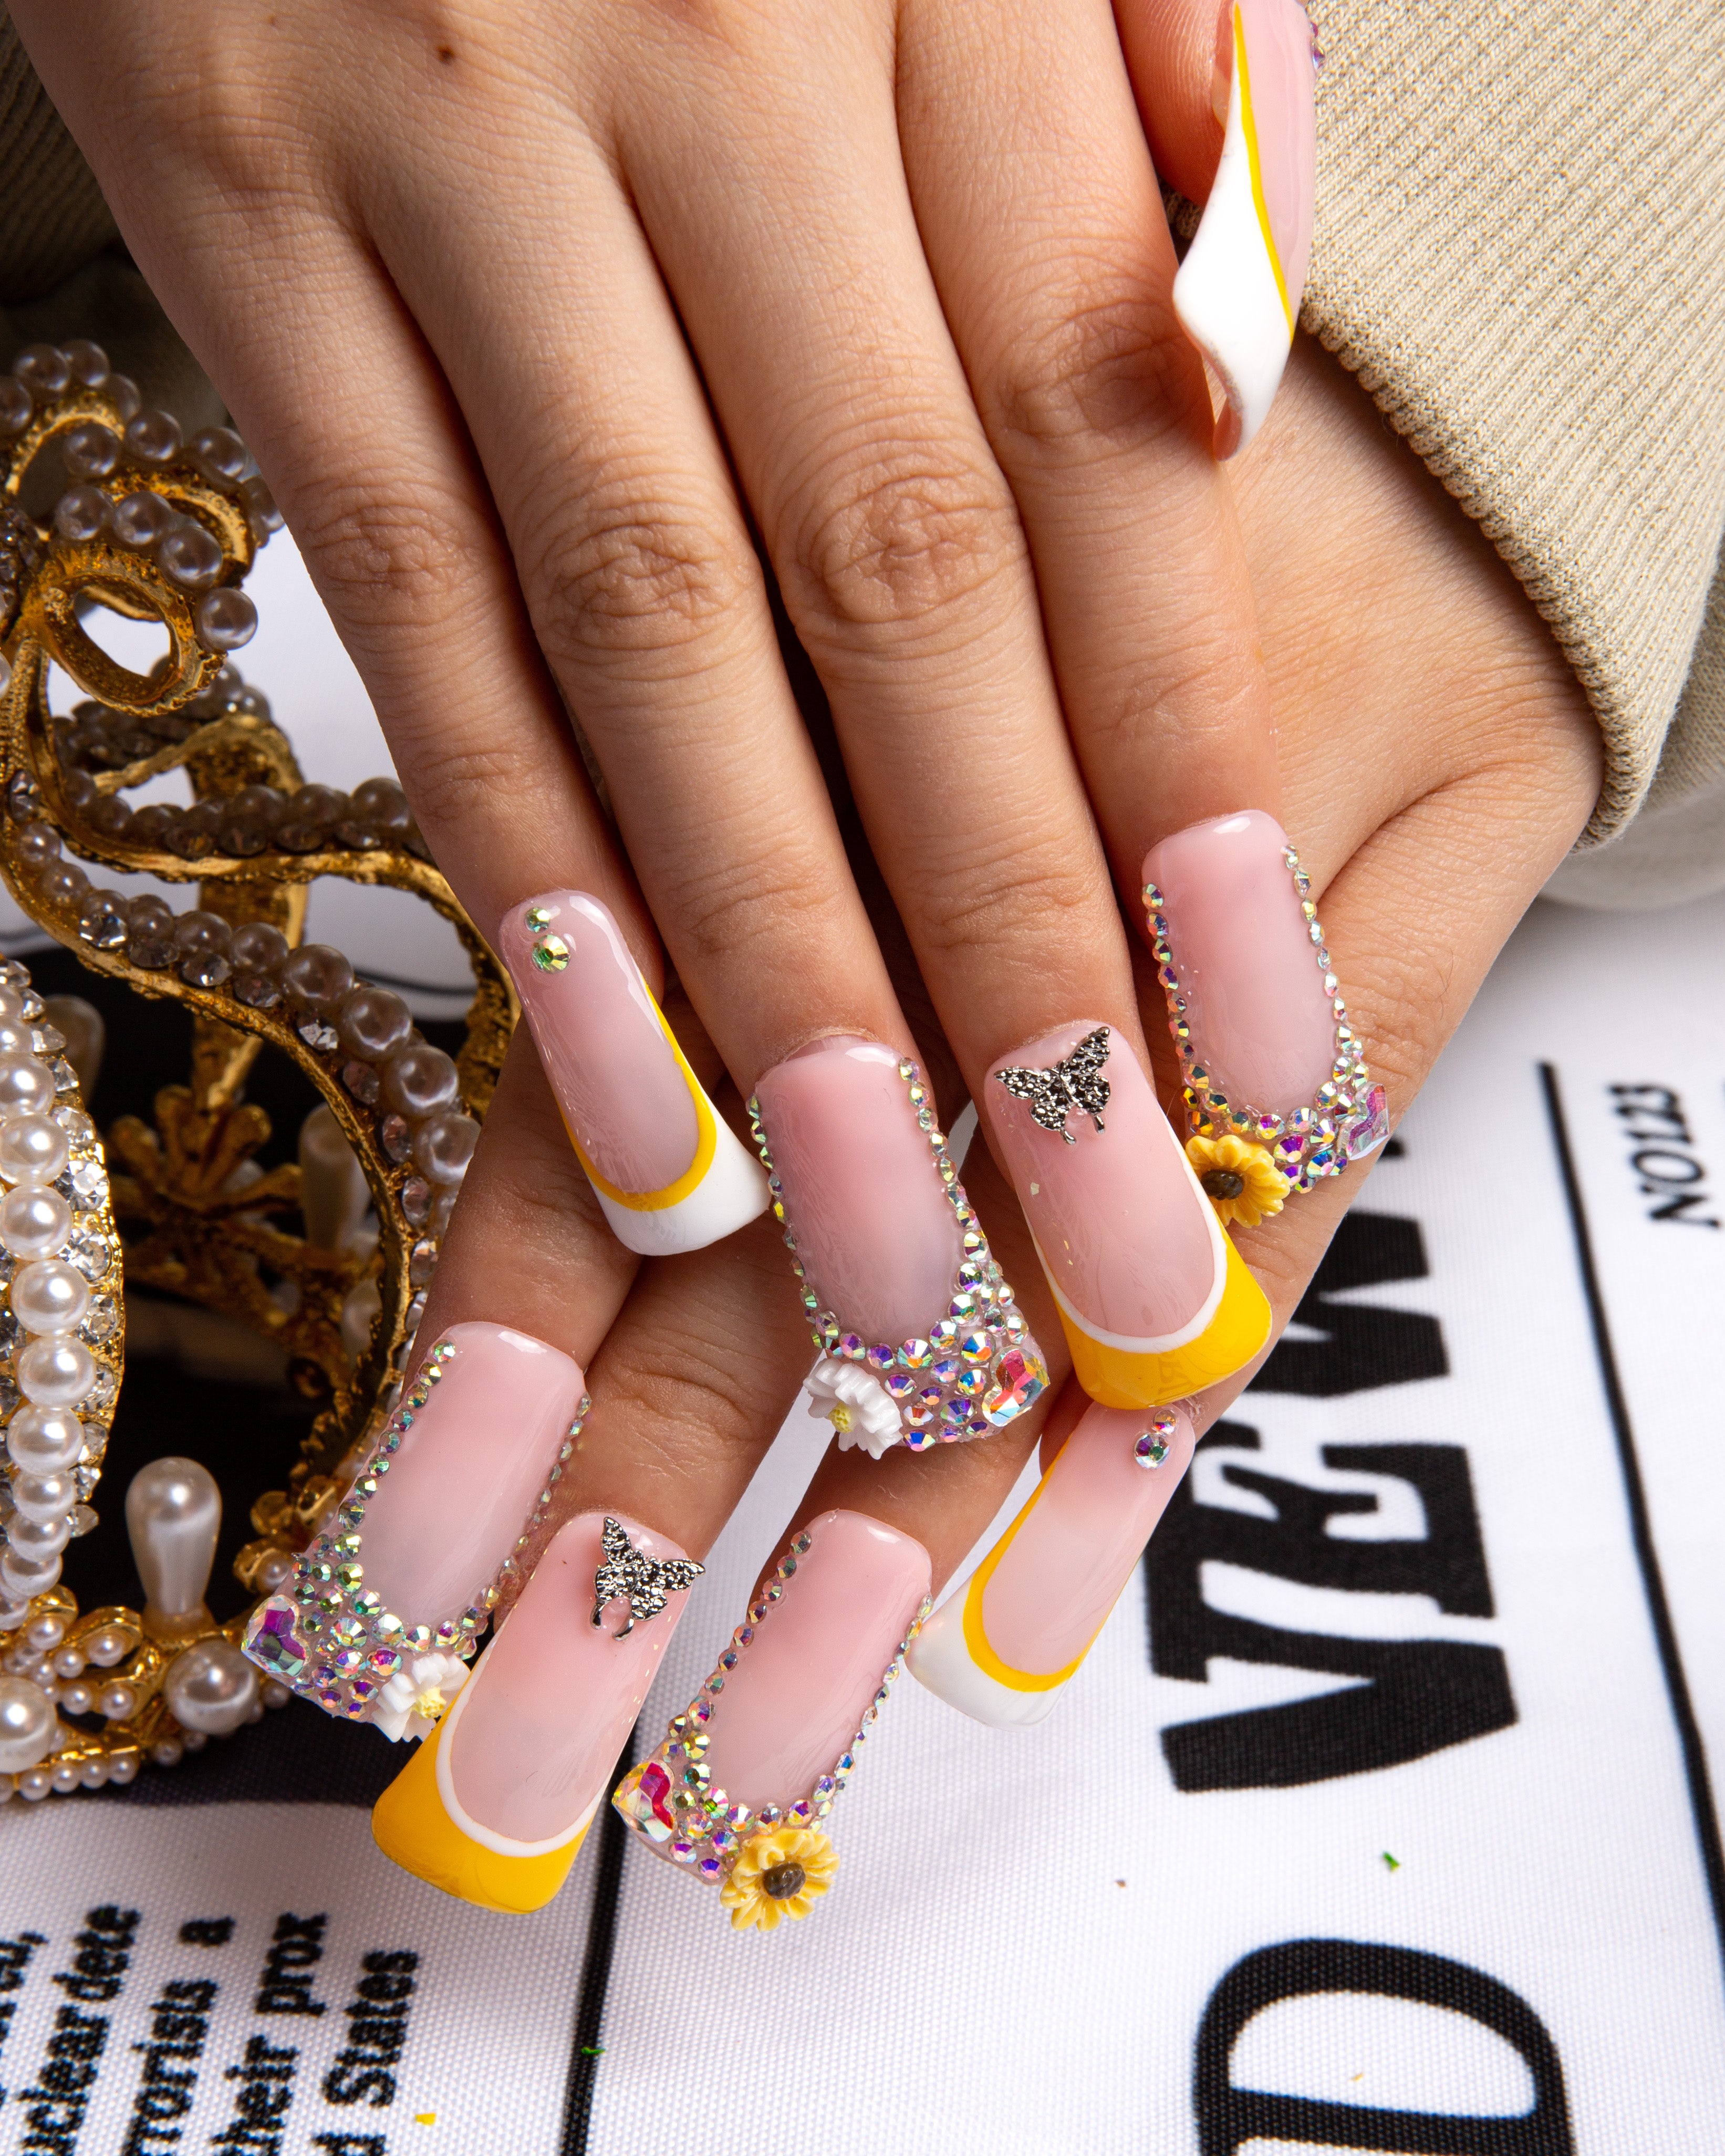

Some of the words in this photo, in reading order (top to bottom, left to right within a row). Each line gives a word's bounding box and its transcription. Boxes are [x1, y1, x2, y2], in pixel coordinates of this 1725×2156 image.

[179, 1915, 236, 1947] a
[255, 1912, 328, 2018] prox
[320, 1949, 419, 2107] States
